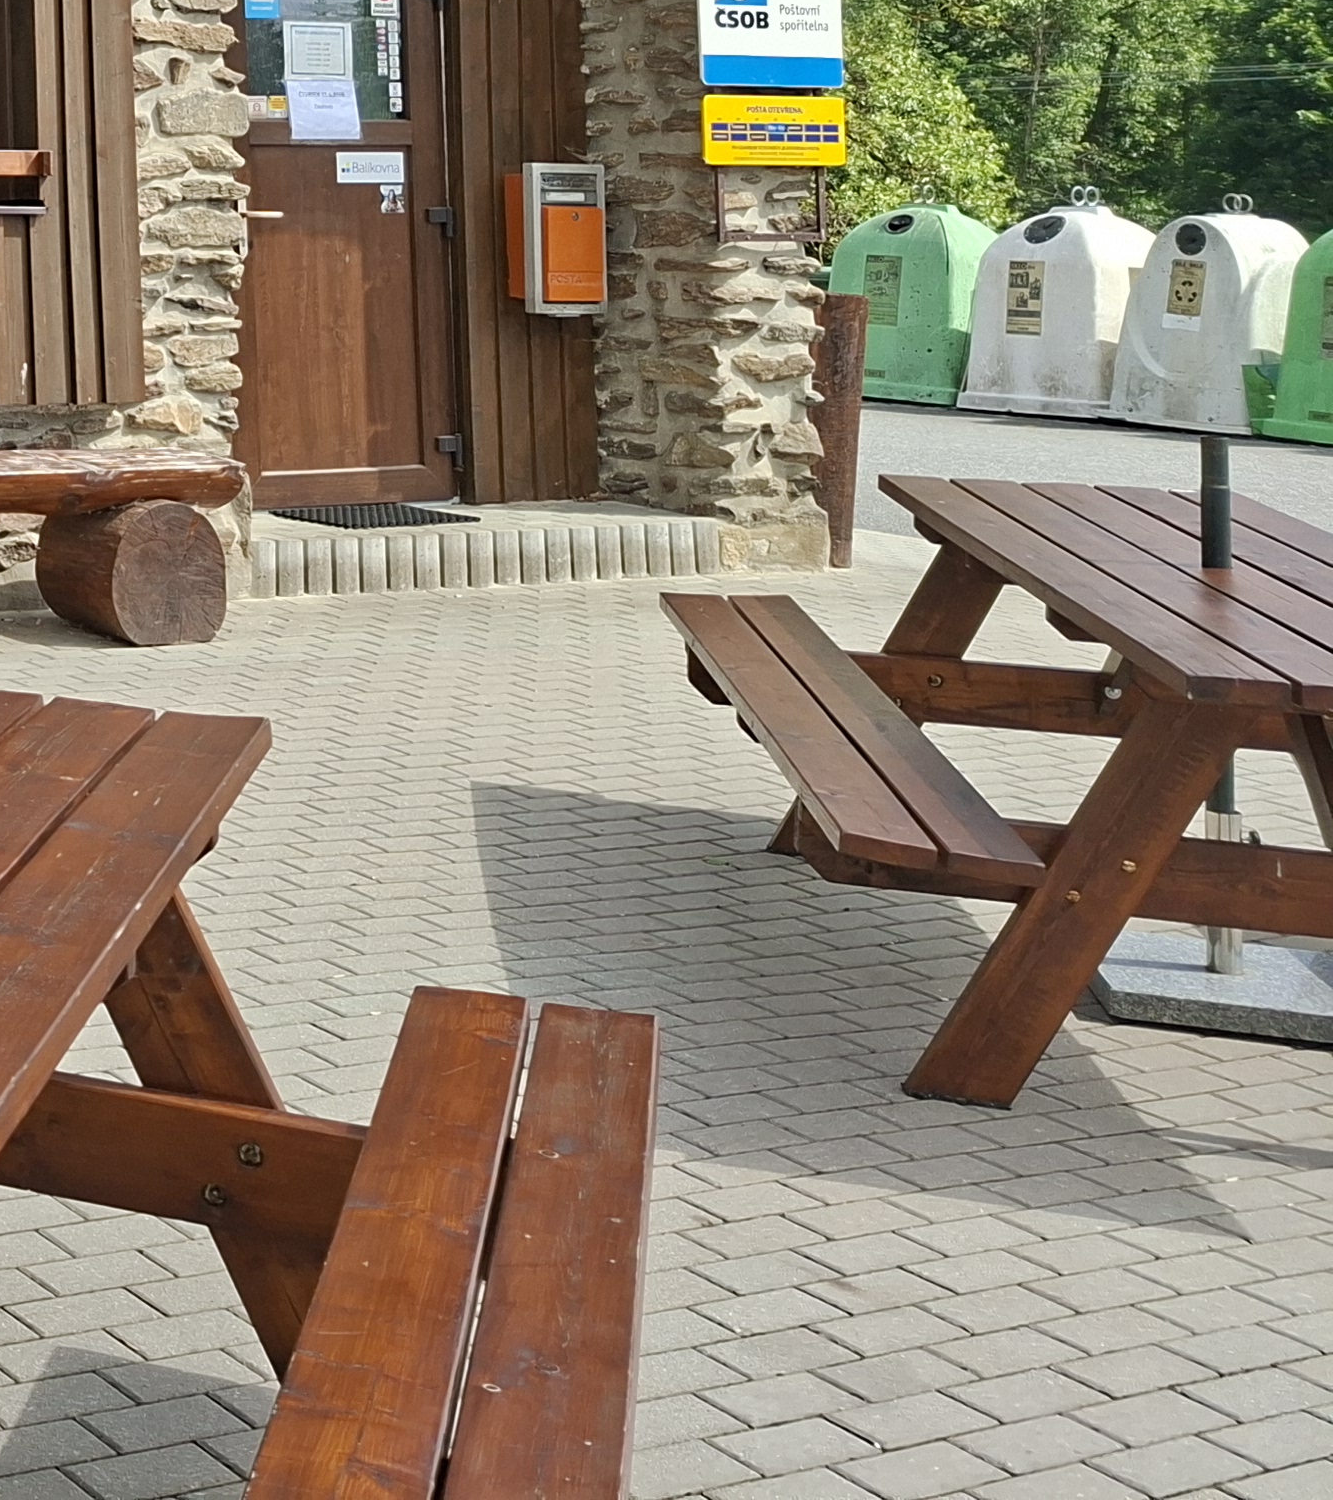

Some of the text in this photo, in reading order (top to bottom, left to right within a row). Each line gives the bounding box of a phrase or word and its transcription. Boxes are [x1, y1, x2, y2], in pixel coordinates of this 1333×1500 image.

[779, 4, 821, 16] Poštovní
[715, 7, 769, 29] ČSOB
[780, 19, 829, 33] spořitelna
[352, 162, 399, 173] Balíkovna
